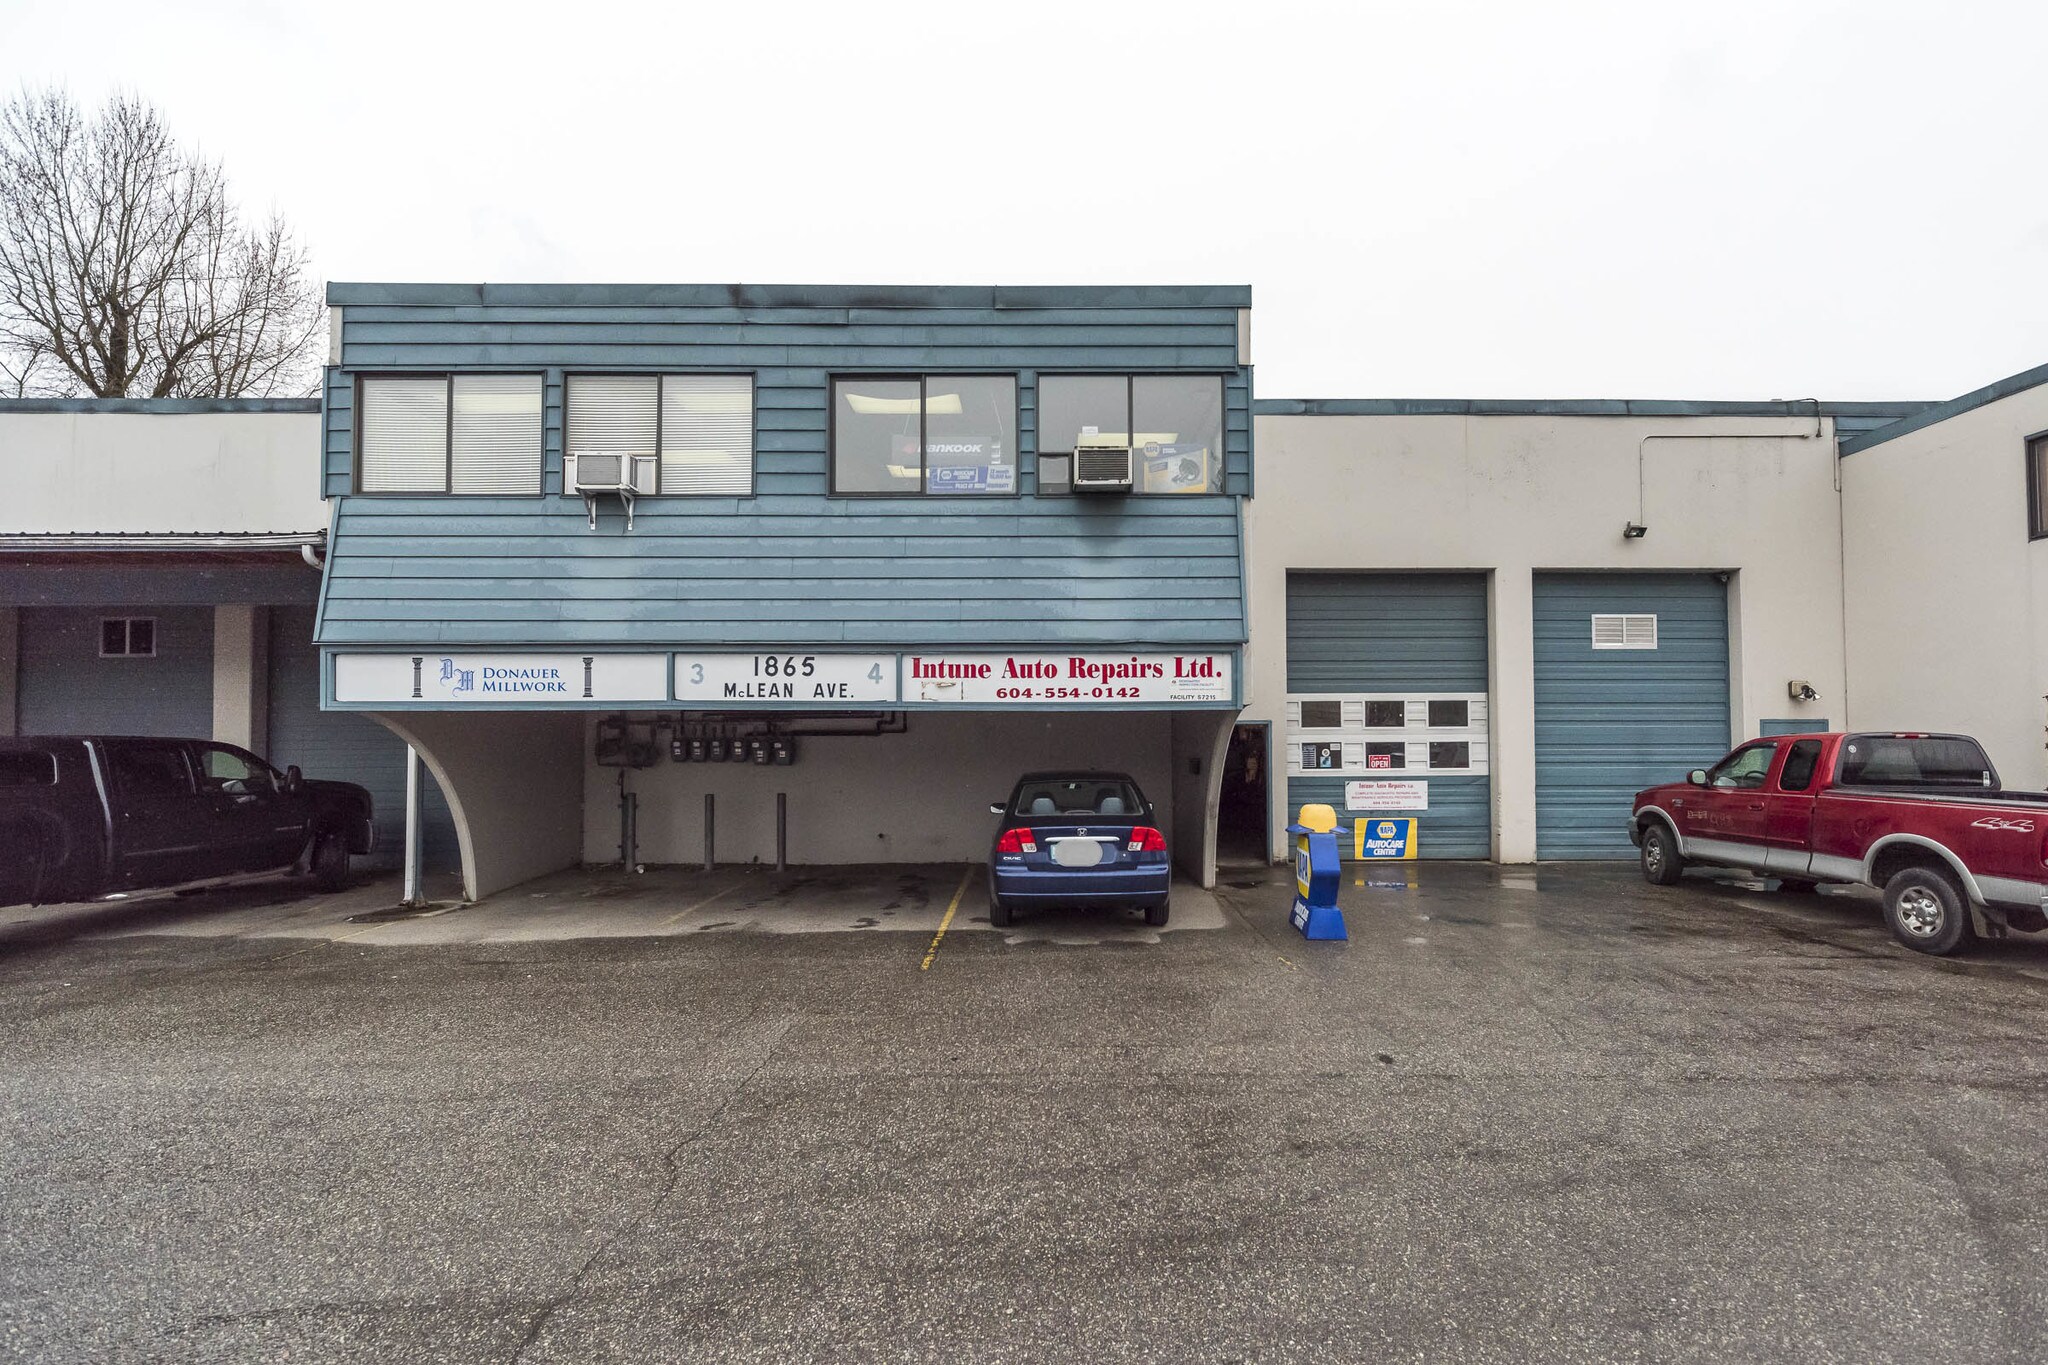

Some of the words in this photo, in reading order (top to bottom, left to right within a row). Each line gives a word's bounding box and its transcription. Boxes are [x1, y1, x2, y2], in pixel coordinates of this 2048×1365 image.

[754, 655, 816, 677] 1865
[911, 657, 991, 679] Intune
[1001, 657, 1058, 679] Auto
[1067, 656, 1163, 684] Repairs
[1173, 656, 1222, 678] Ltd.
[483, 667, 560, 679] DONAUER
[689, 663, 704, 685] 3
[867, 662, 884, 684] 4
[482, 680, 567, 692] MILLWORK
[813, 682, 855, 698] AVE.
[996, 687, 1140, 699] 604-554-0142
[1370, 760, 1389, 768] OPEN
[1379, 826, 1395, 835] NAPA
[1373, 848, 1397, 856] CENTRE
